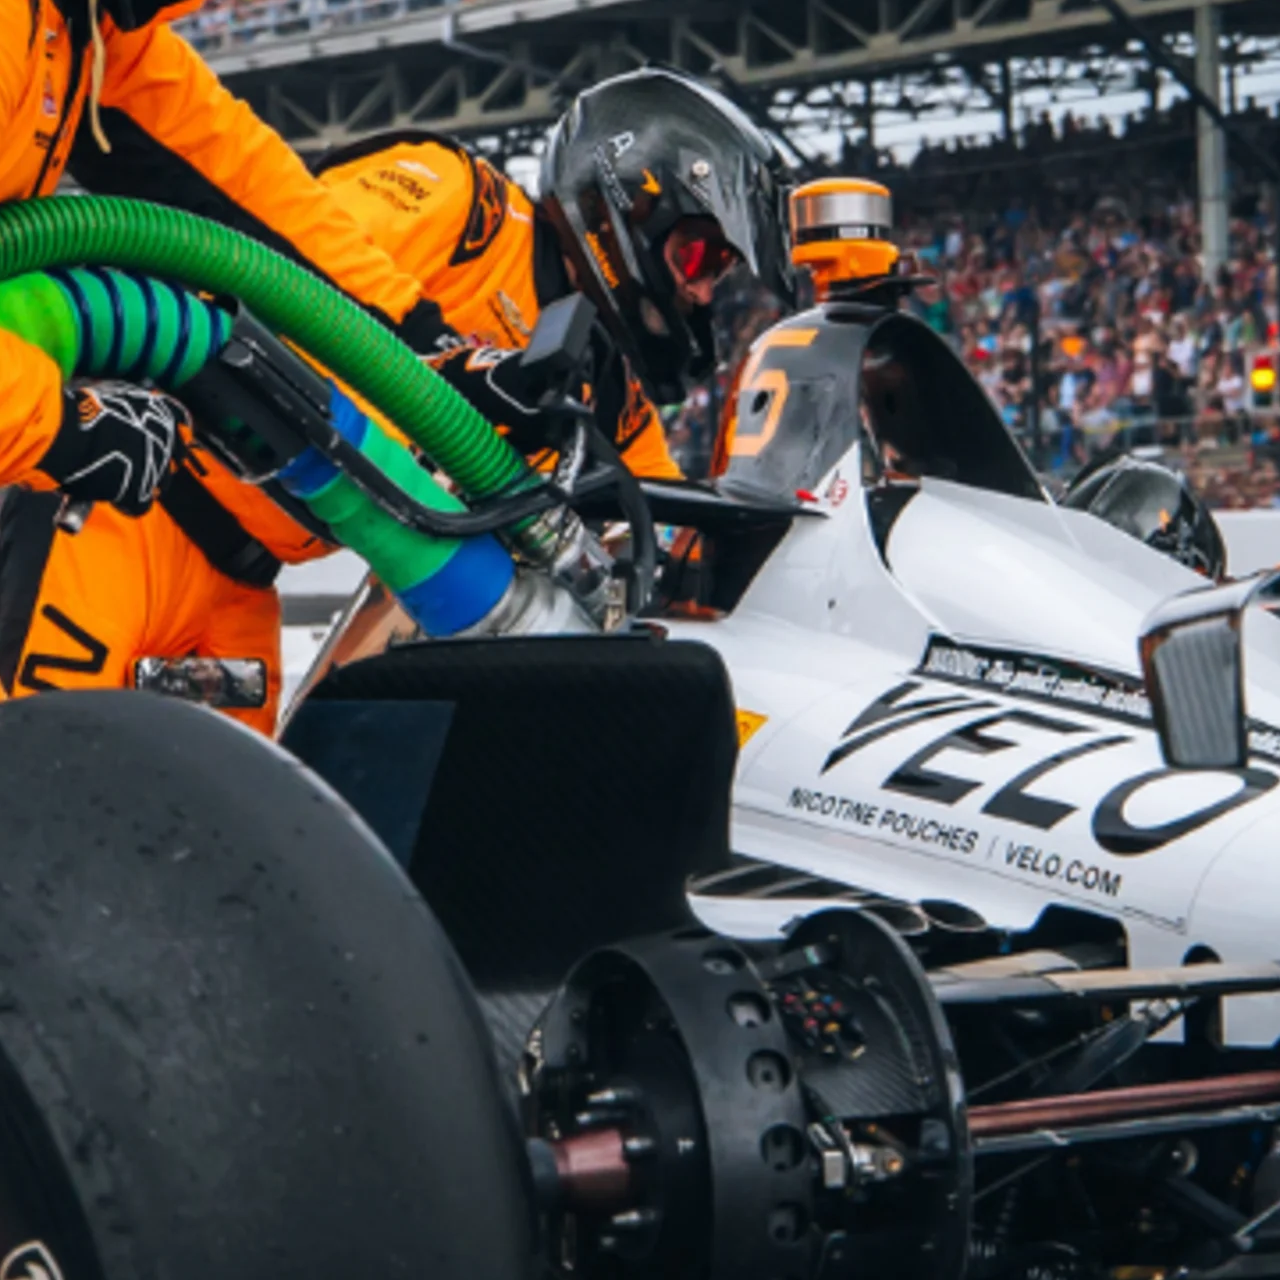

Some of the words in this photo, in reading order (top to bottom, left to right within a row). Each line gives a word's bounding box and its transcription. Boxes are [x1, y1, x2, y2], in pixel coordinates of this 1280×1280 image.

[820, 681, 1280, 857] VELO
[786, 787, 877, 827] NICOTINE
[877, 808, 978, 854] POUCHES
[1004, 841, 1122, 896] VELO.COM
